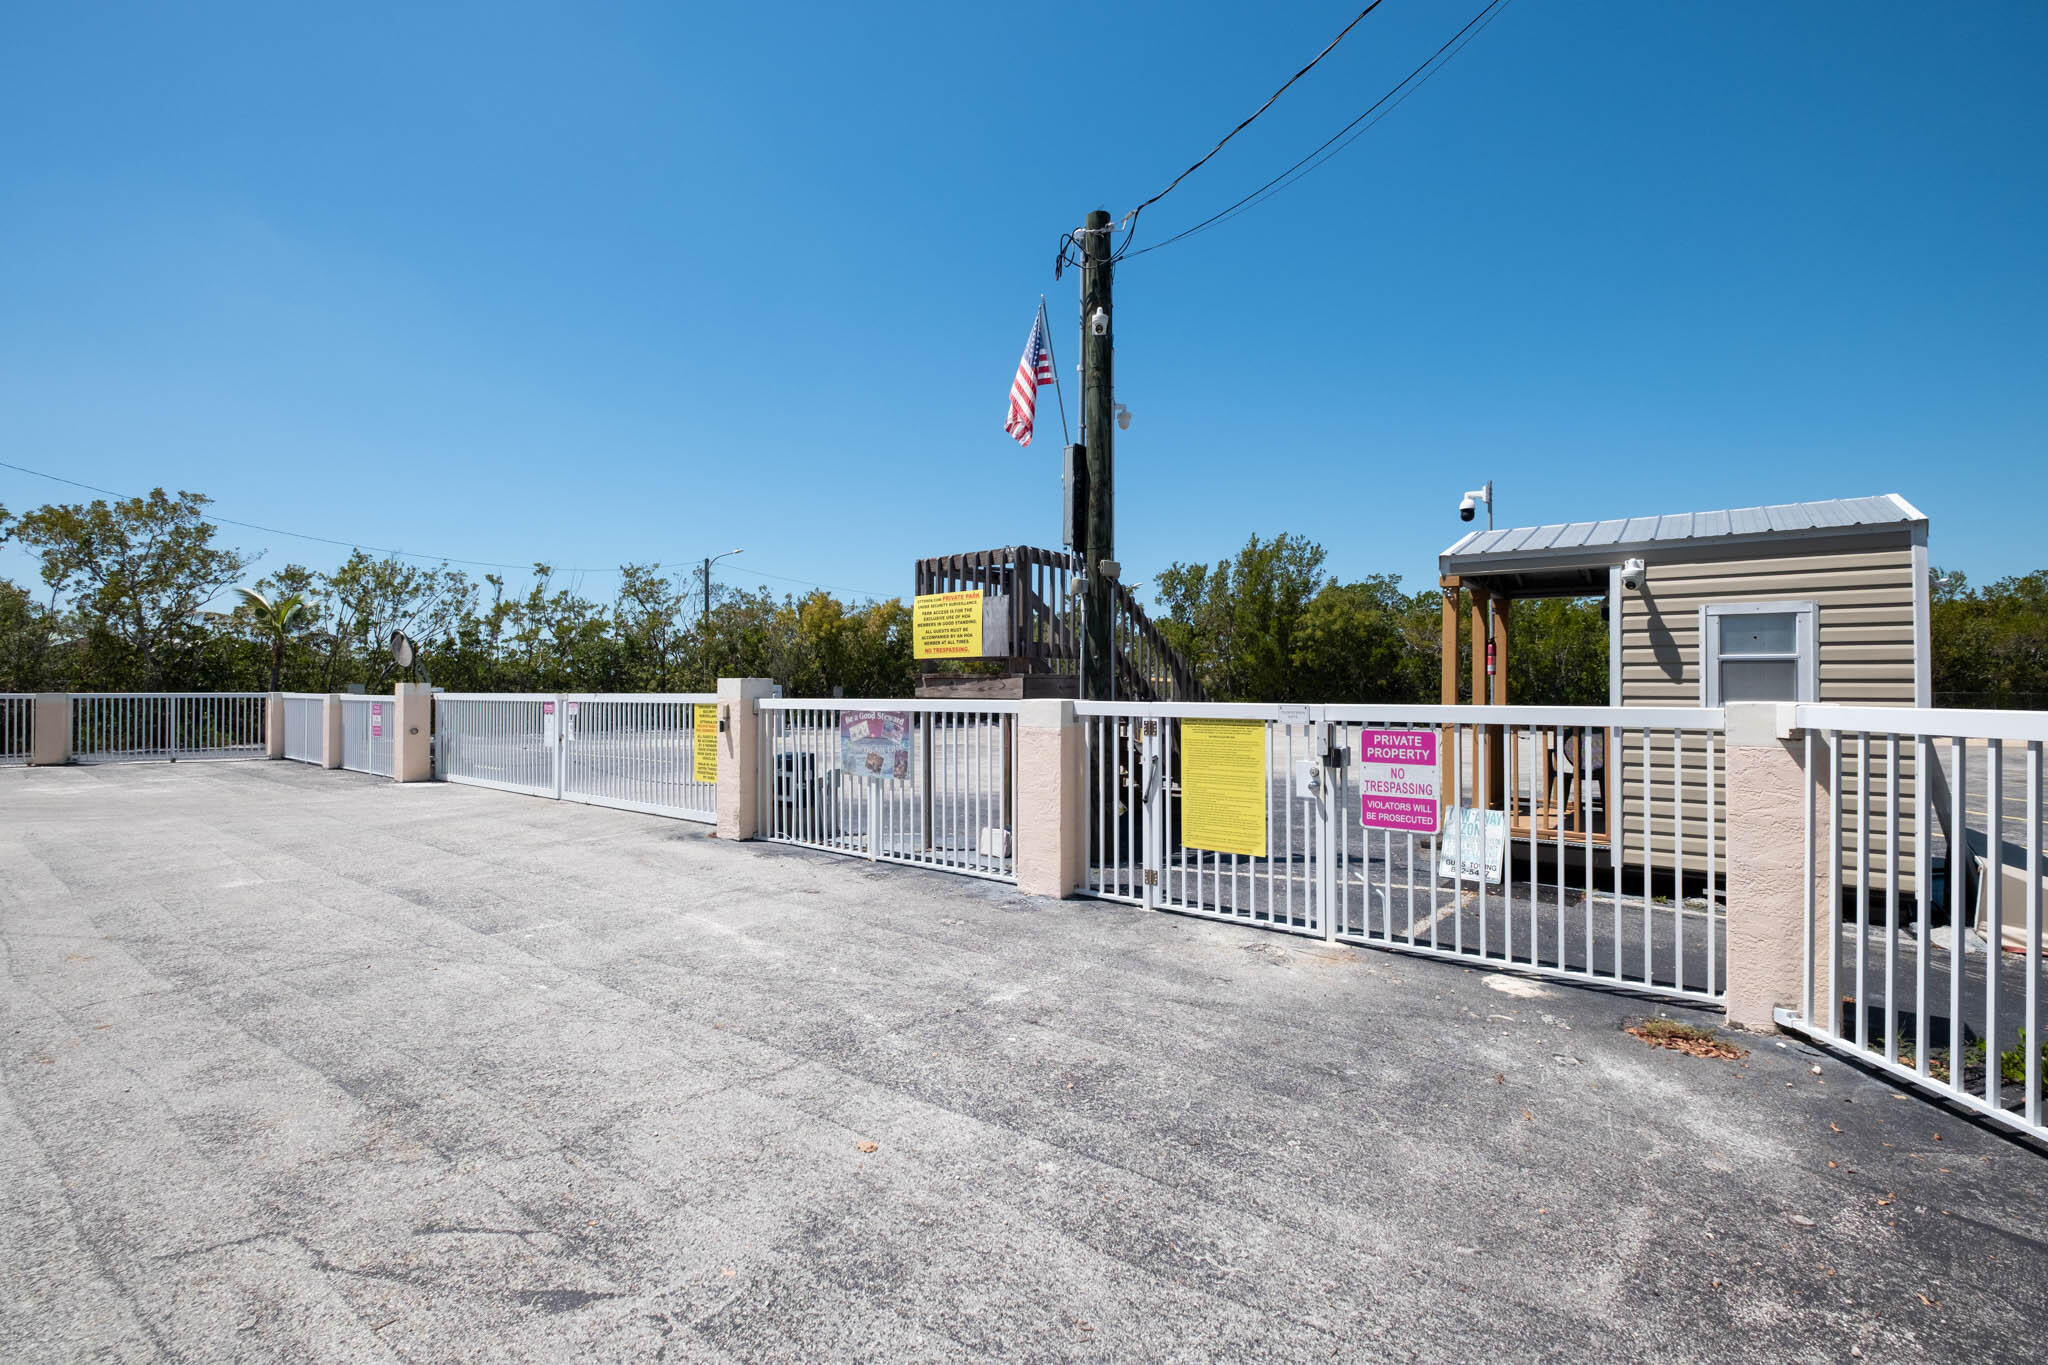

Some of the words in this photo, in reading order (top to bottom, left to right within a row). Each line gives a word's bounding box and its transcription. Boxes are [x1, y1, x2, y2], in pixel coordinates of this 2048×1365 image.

[965, 592, 980, 600] PARK
[845, 715, 853, 725] Be
[859, 711, 876, 721] Good
[876, 712, 905, 726] Steward
[1373, 734, 1423, 747] PRIVATE
[1366, 747, 1430, 761] PROPERTY
[1390, 767, 1406, 779] NO
[1364, 779, 1434, 797] TRESPASSING
[1367, 800, 1412, 812] VIOLATORS
[1413, 803, 1433, 814] WILL
[1366, 812, 1377, 821] BE
[1378, 813, 1434, 826] PROSECUTED
[1461, 822, 1481, 837] ZON
[1445, 859, 1466, 868] GUS
[1470, 862, 1497, 872] TOING
